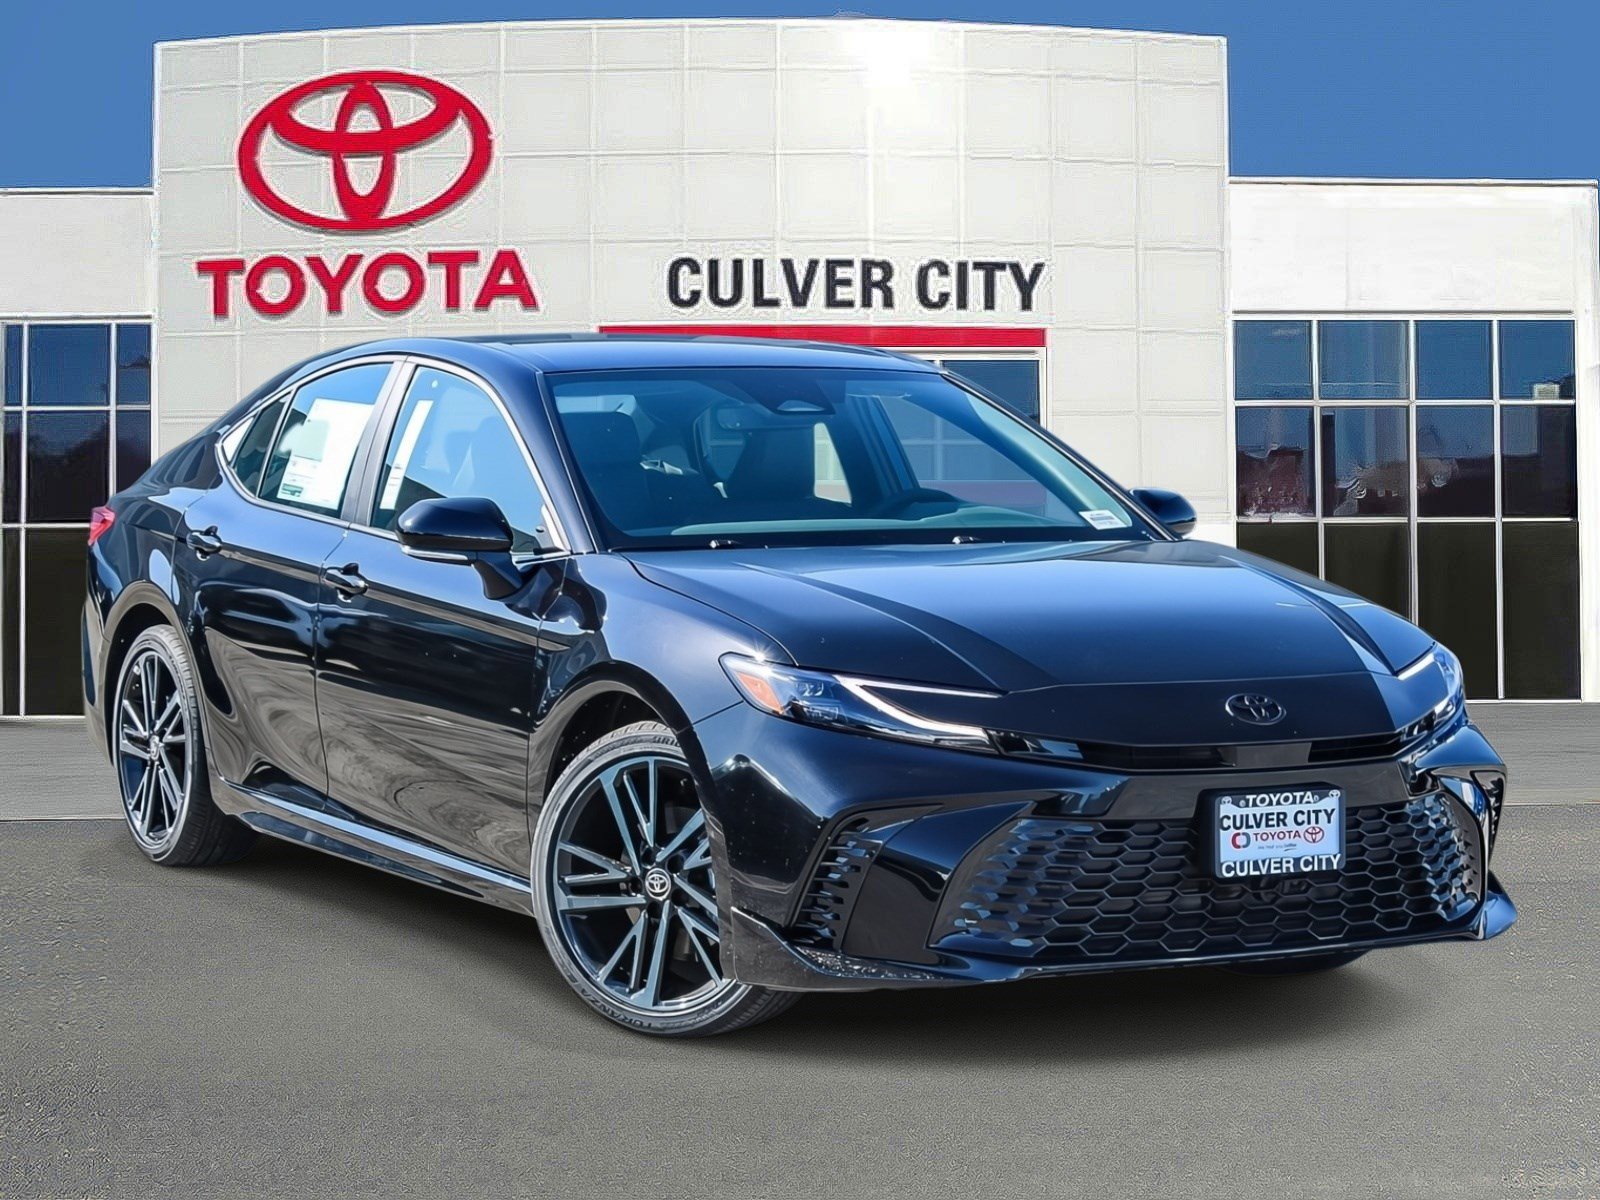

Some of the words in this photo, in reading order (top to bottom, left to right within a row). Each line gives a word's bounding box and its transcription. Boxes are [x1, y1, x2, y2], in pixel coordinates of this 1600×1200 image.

[196, 249, 539, 317] TOYOTA
[667, 257, 895, 309] CULVER
[915, 260, 1045, 311] CITY
[1245, 791, 1314, 807] TOYOTA
[1220, 811, 1288, 831] CULVER
[1293, 808, 1336, 826] CITY
[1253, 830, 1301, 842] TOYOTA
[1221, 858, 1294, 877] CULVER
[1300, 854, 1341, 872] CITY
